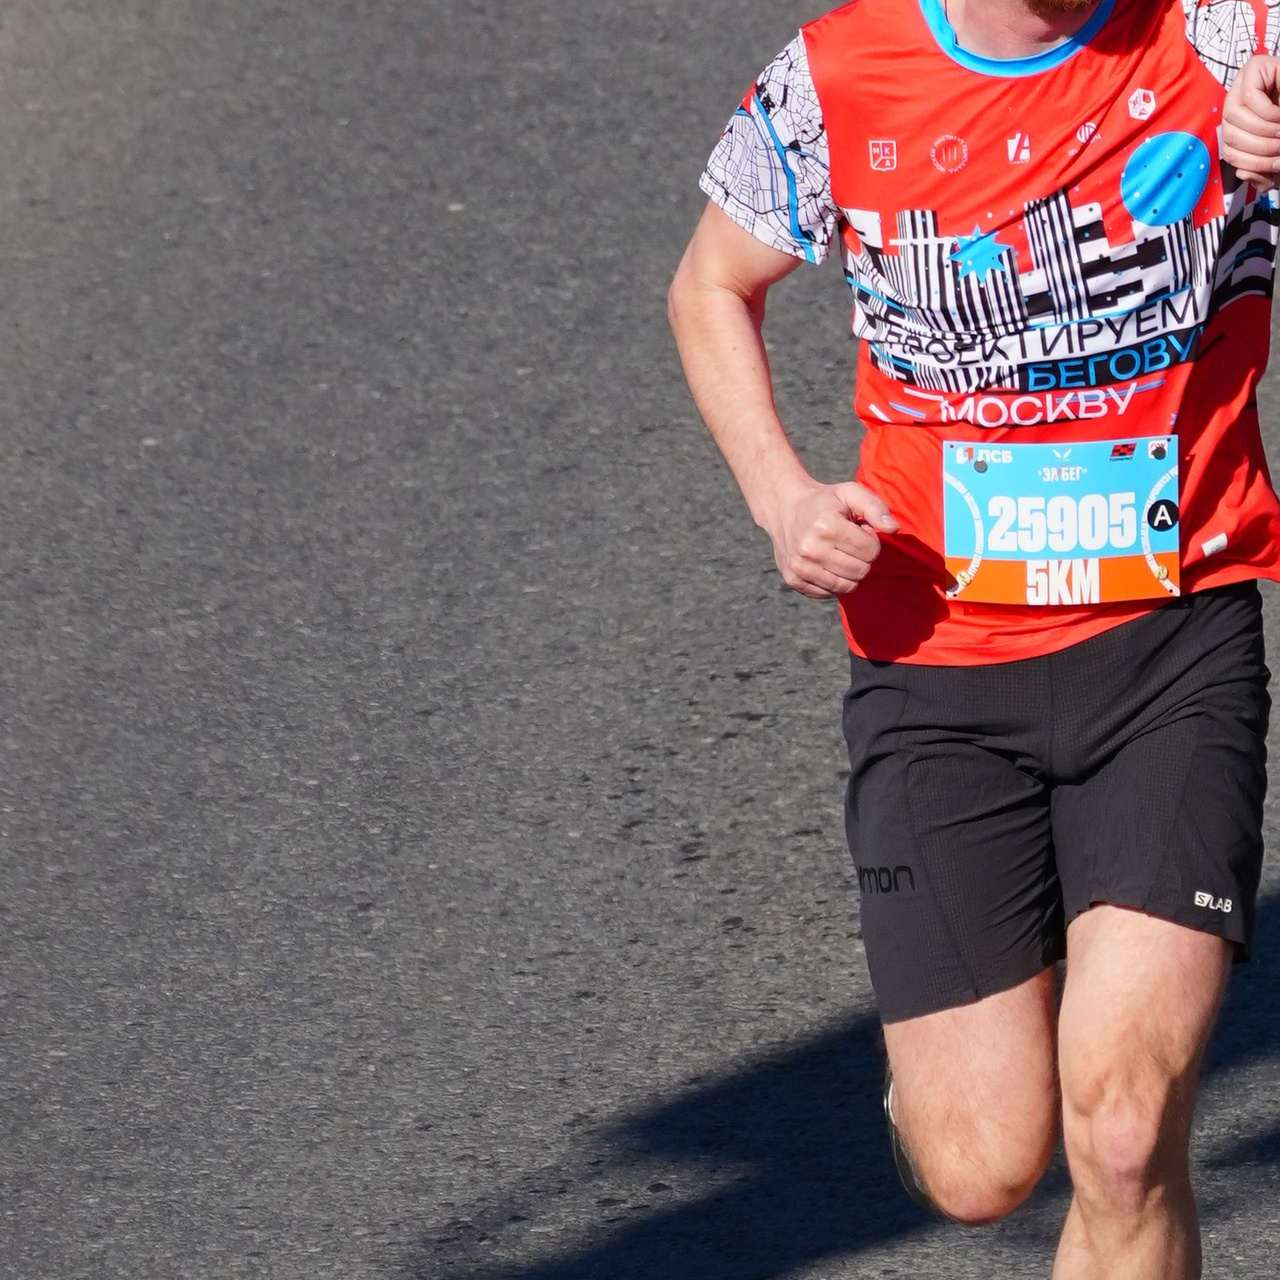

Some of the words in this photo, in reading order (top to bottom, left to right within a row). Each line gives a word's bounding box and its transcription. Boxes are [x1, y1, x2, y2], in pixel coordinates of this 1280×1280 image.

[1026, 328, 1197, 393] БЕГОВУ
[940, 382, 1137, 428] МОСКВУ
[987, 491, 1137, 553] 25905
[1153, 505, 1173, 527] A
[858, 865, 916, 894] mon
